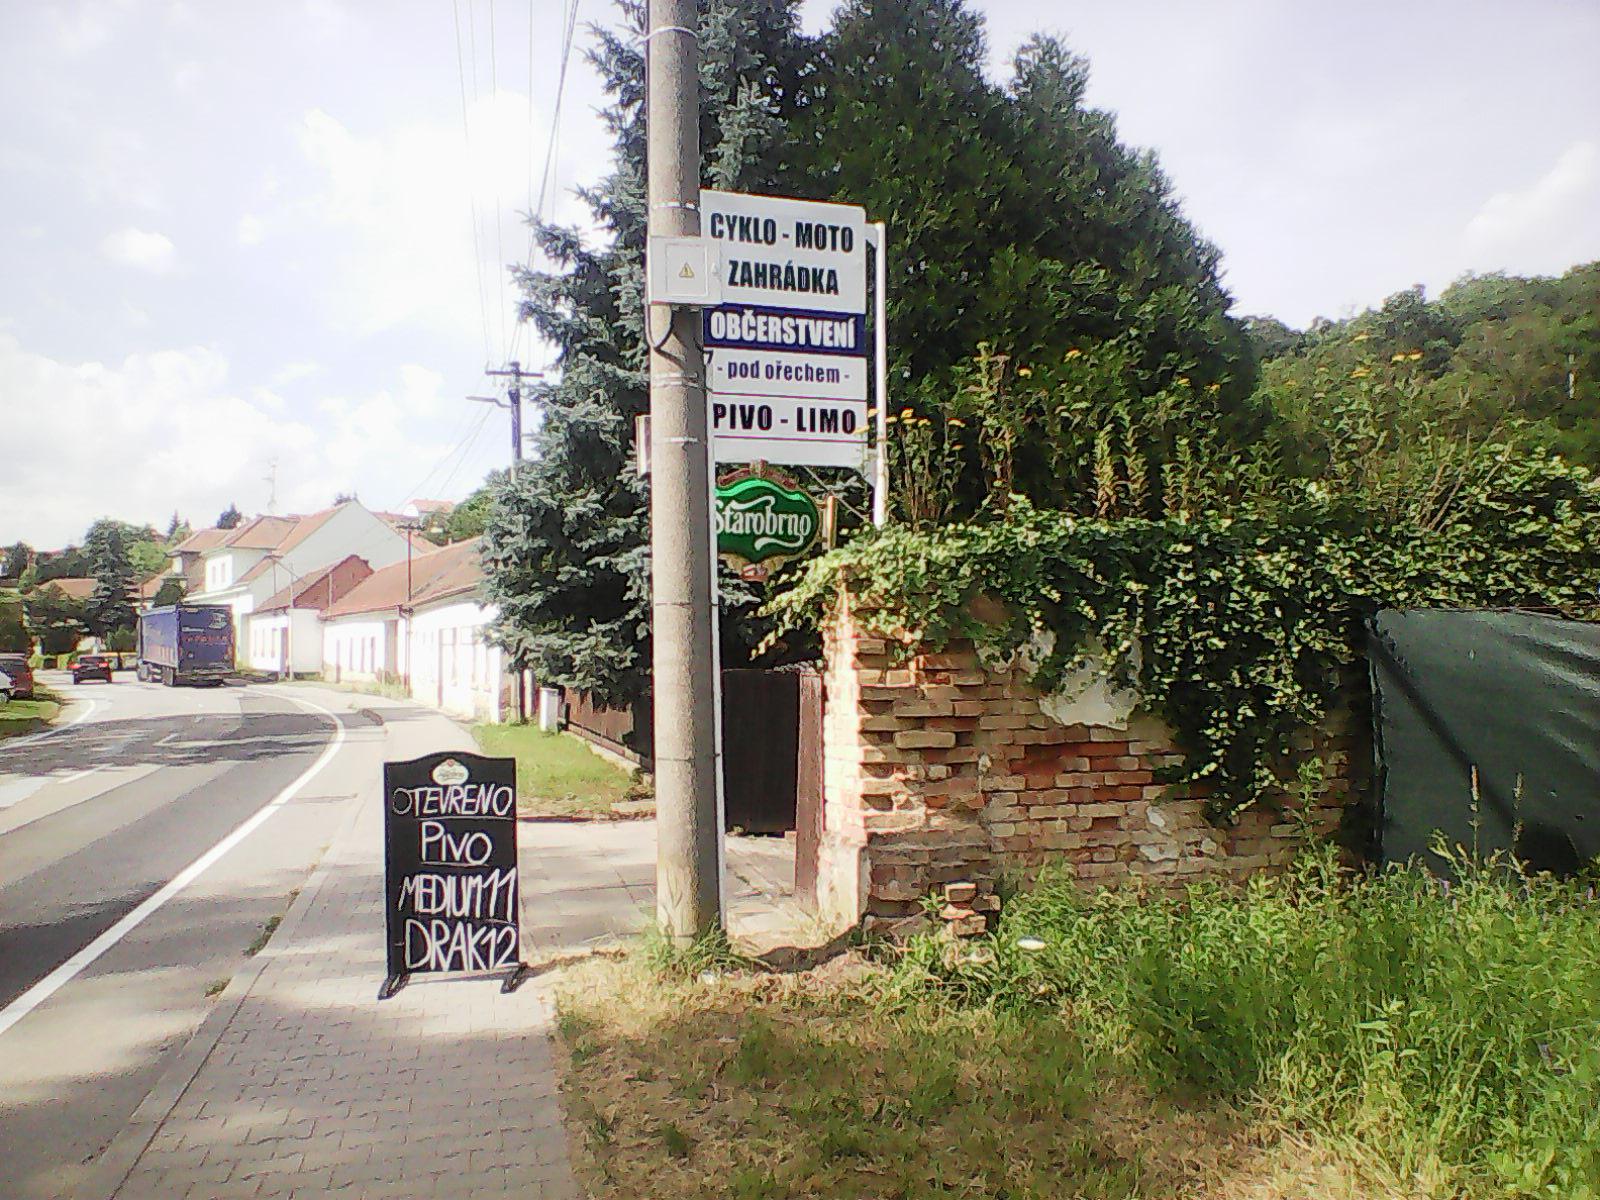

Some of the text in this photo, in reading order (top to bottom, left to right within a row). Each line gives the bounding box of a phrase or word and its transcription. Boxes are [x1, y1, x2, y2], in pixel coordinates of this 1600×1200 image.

[711, 212, 776, 245] CYKLO
[795, 222, 853, 253] MOTO
[728, 260, 839, 295] ZAHRÁDKA
[711, 310, 855, 349] OBČERSTVENÍ
[727, 361, 760, 380] pod
[765, 362, 840, 383] ořechem
[713, 403, 772, 432] PIVO
[797, 407, 856, 434] LIMO
[714, 496, 812, 550] Starobrno
